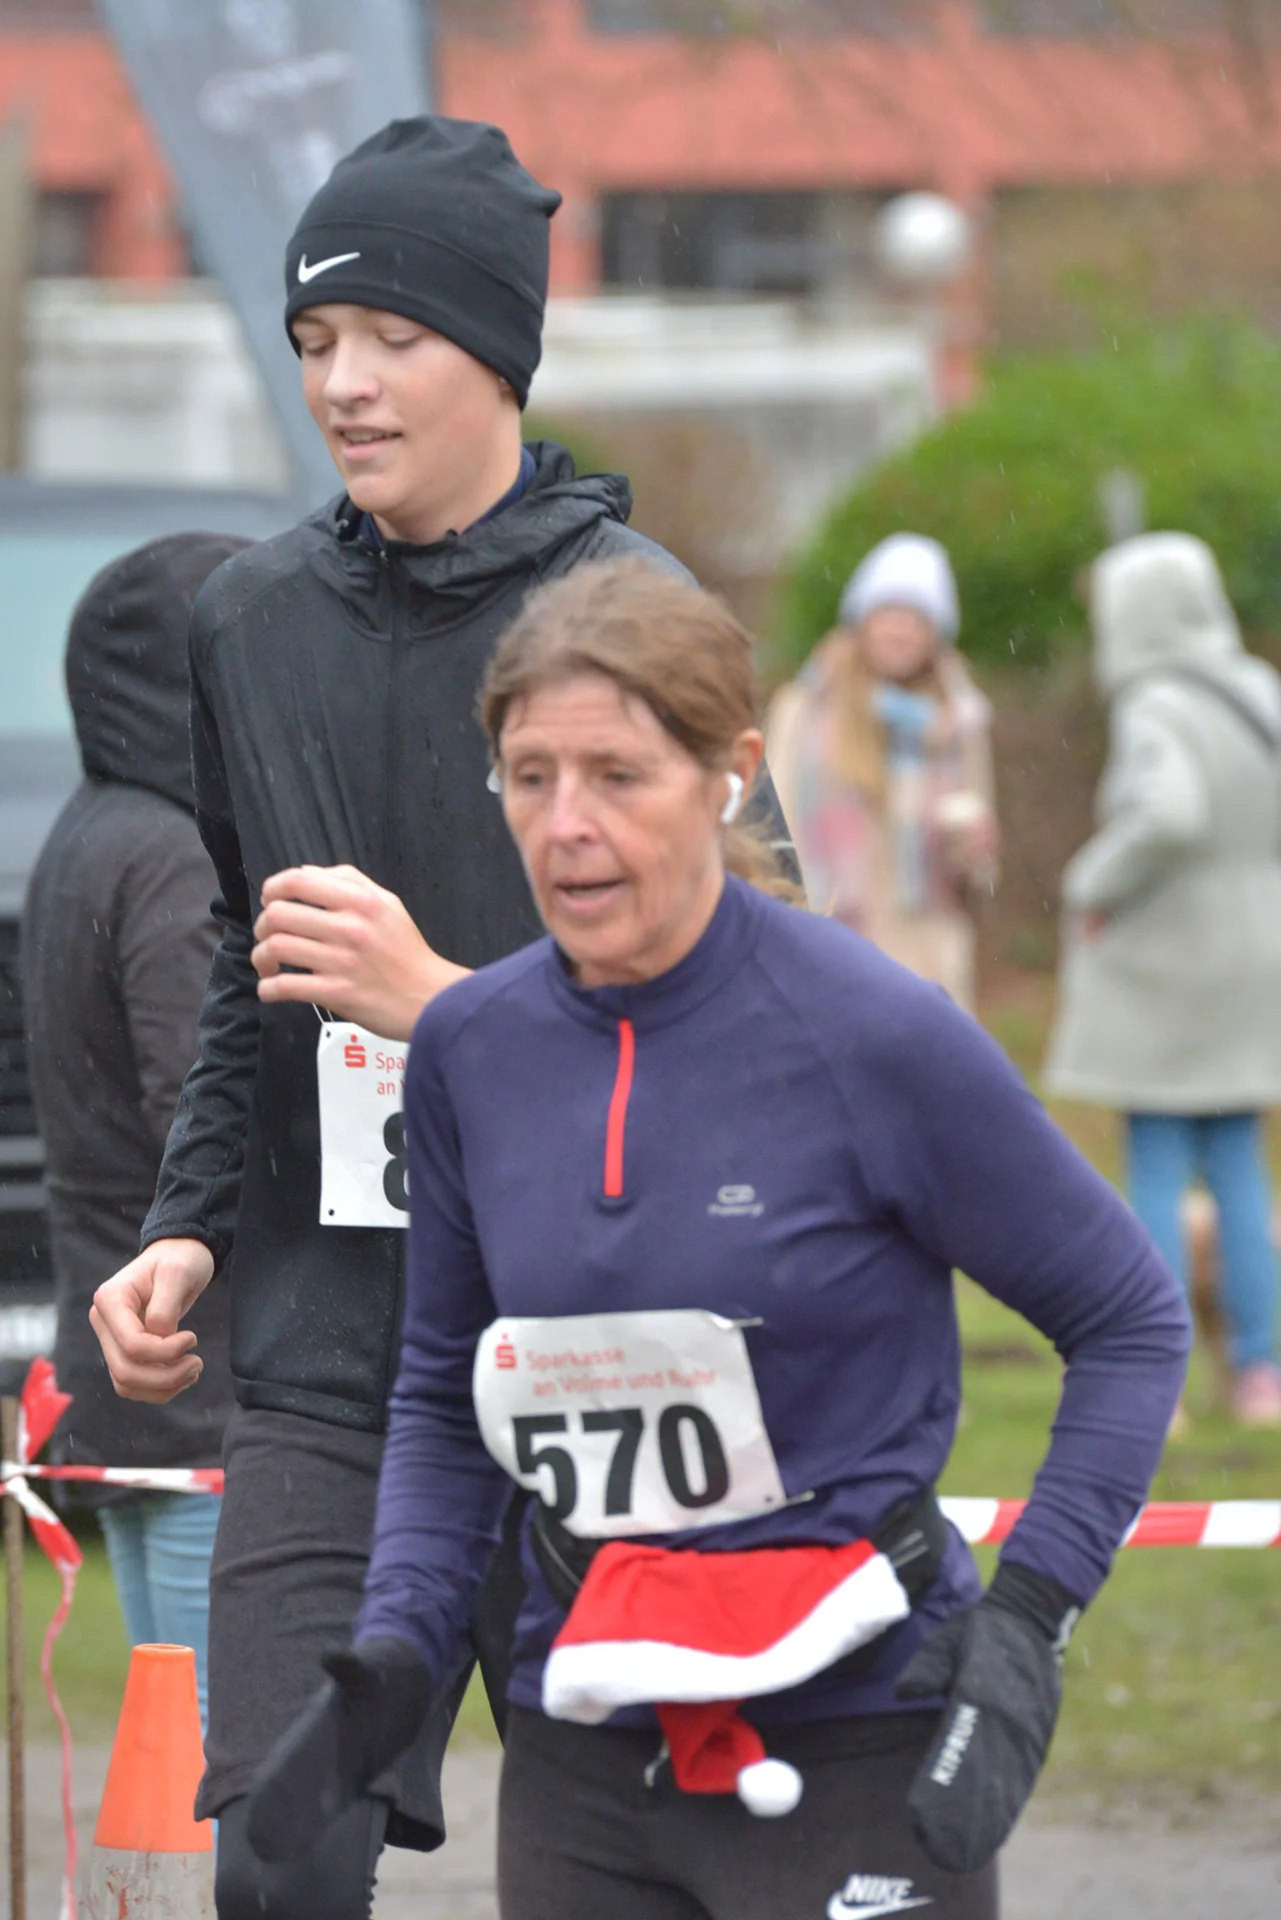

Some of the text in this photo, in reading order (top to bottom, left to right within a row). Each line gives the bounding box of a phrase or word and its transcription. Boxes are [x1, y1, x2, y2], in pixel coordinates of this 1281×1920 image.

[376, 1081, 396, 1095] an
[525, 1347, 626, 1372] Sparkasse
[533, 1368, 717, 1397] an Volme und Ruhr
[511, 1403, 731, 1522] 570
[842, 1873, 915, 1904] NIKE
